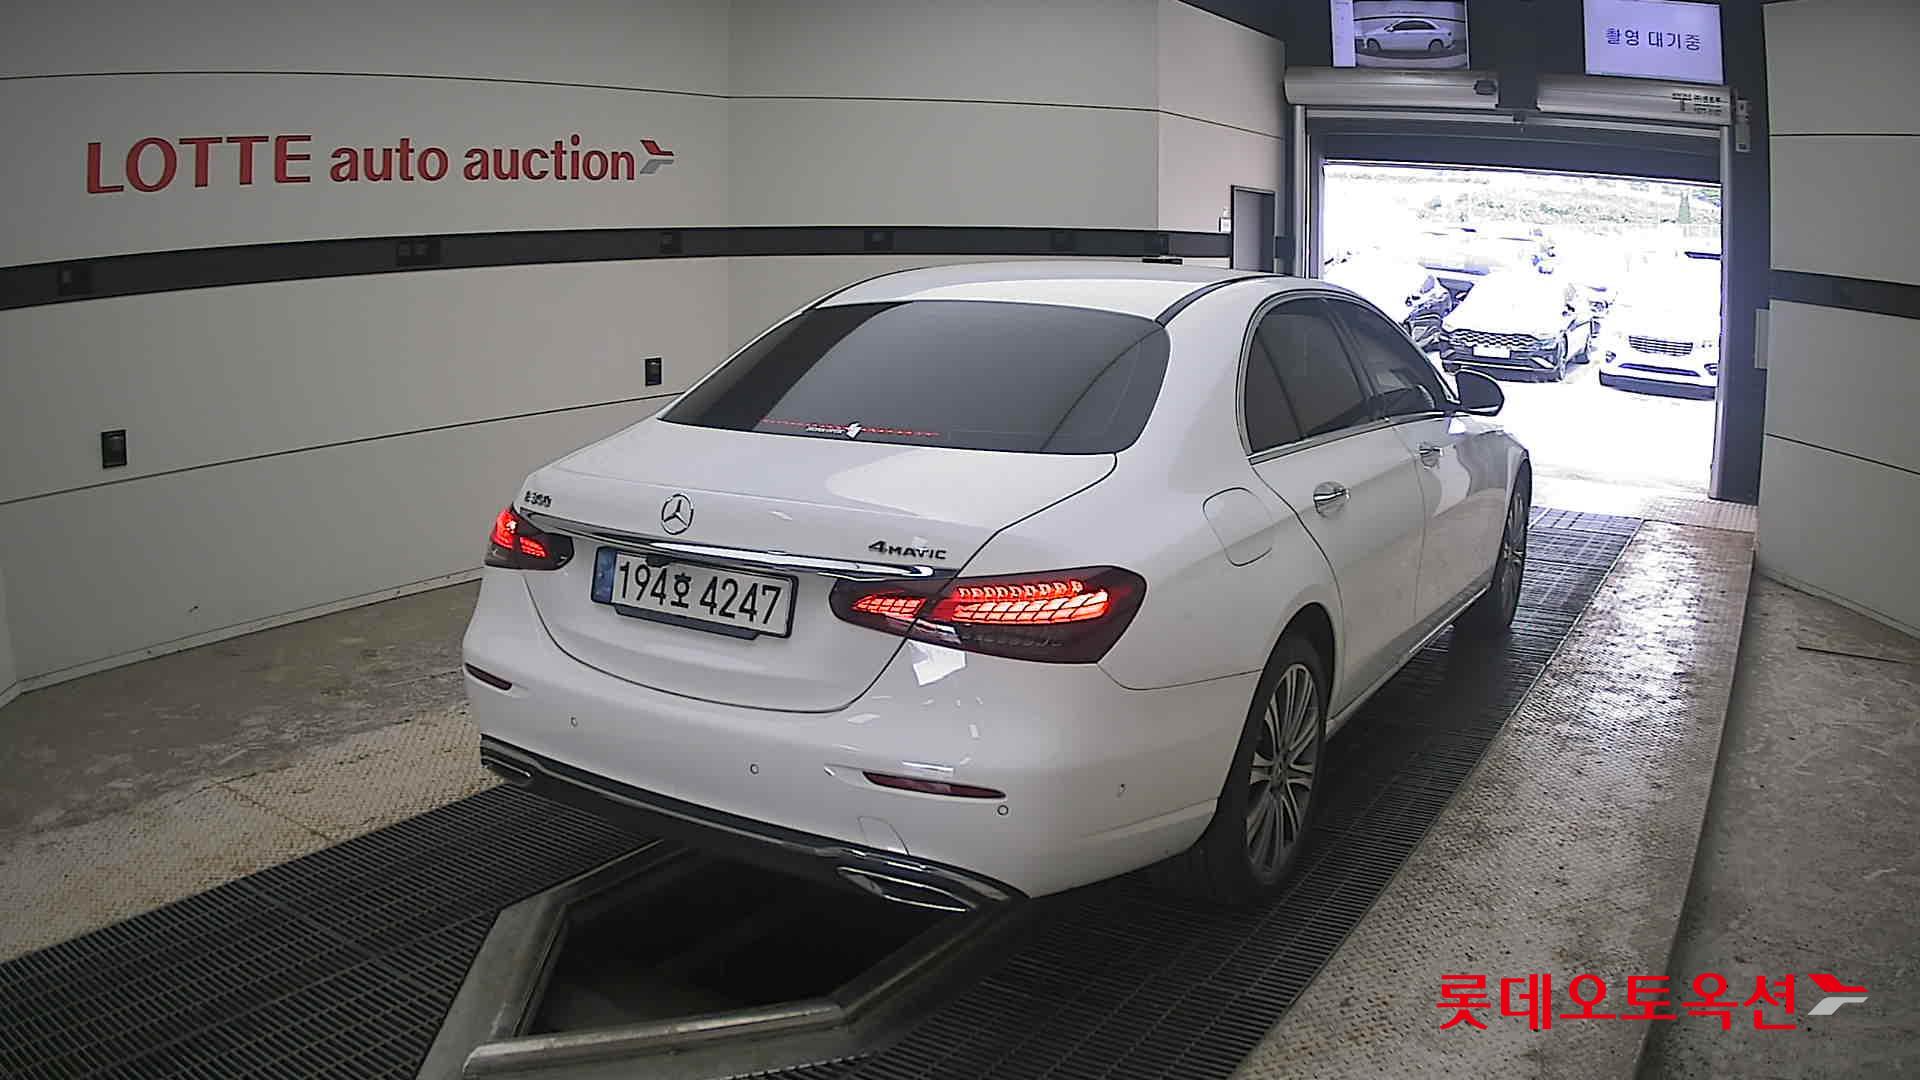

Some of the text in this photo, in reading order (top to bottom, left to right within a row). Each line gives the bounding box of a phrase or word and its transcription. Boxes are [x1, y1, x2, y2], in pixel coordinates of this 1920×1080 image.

[1648, 31, 1701, 52] 대기중
[86, 133, 635, 195] LOTTE auto auction
[699, 575, 783, 625] 4247
